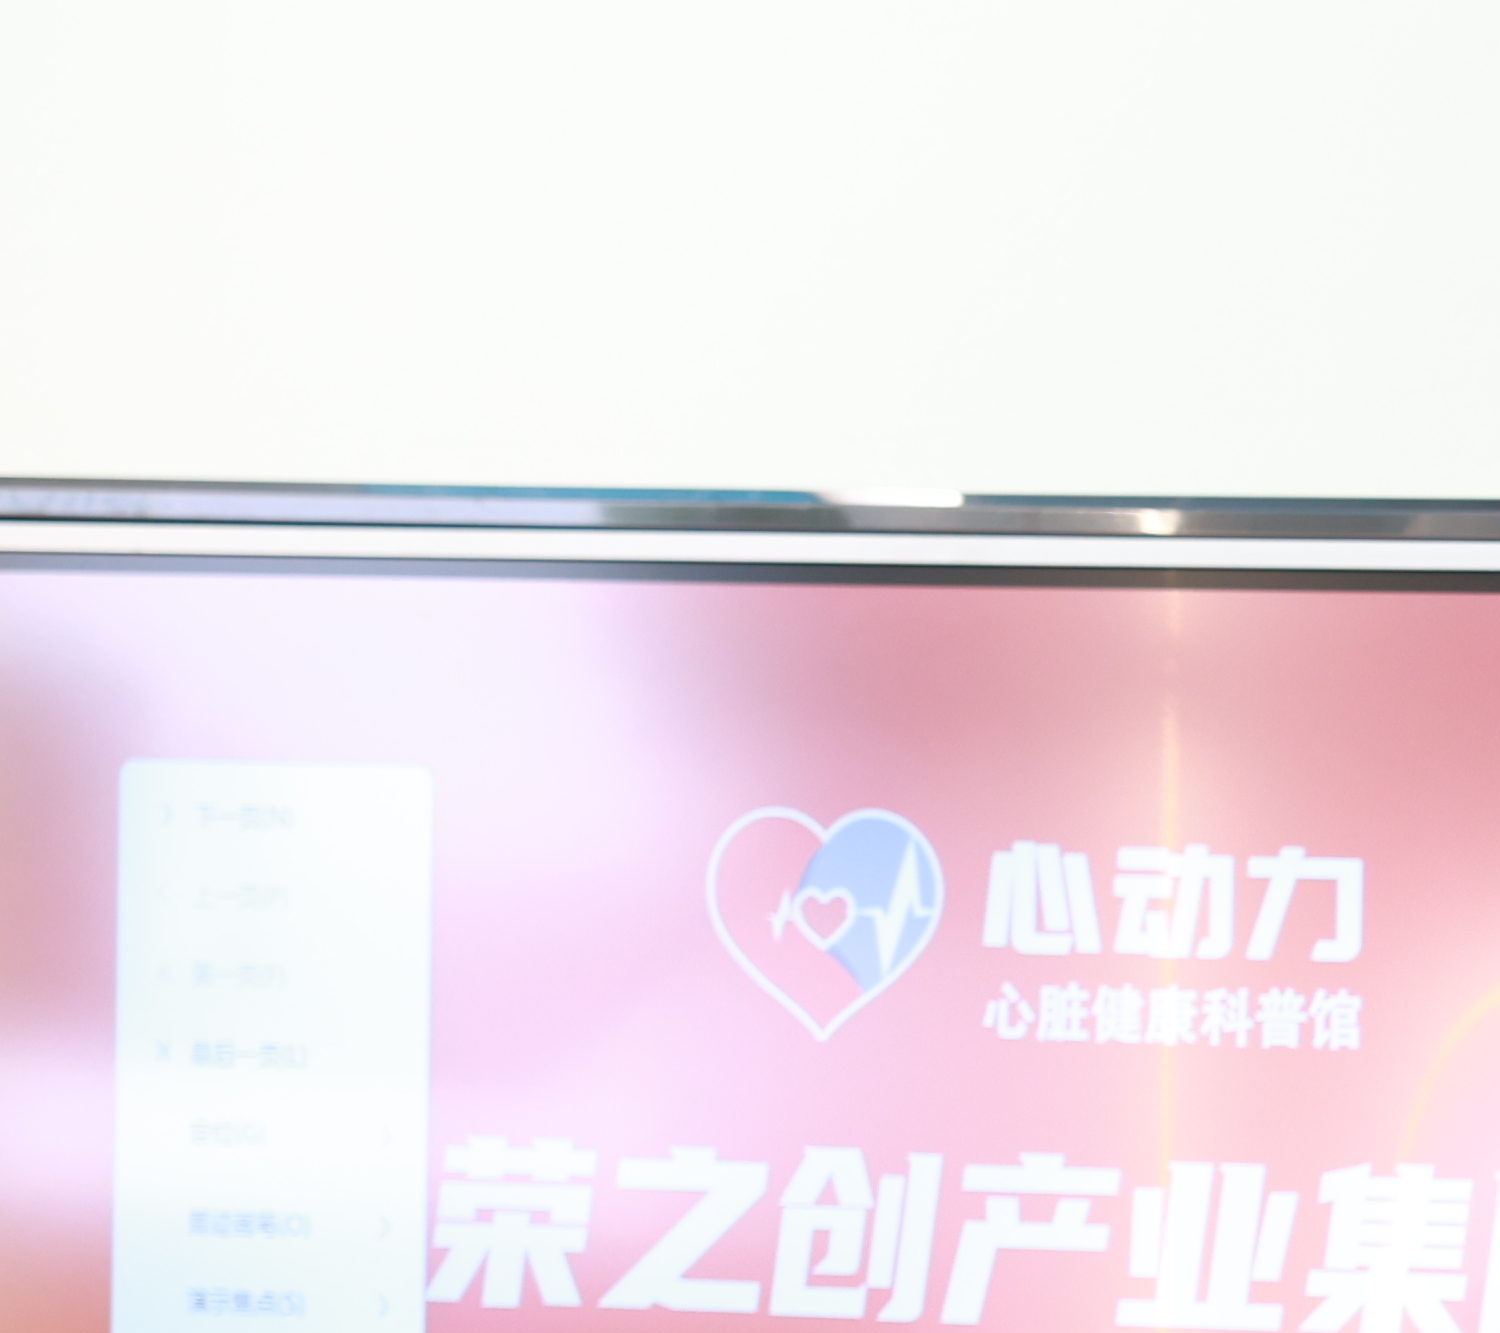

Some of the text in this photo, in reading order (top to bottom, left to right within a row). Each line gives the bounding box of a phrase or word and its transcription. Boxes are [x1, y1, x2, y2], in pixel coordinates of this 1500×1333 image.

[982, 840, 1364, 962] 心动力
[983, 981, 1363, 1051] 心脏健康科普馆
